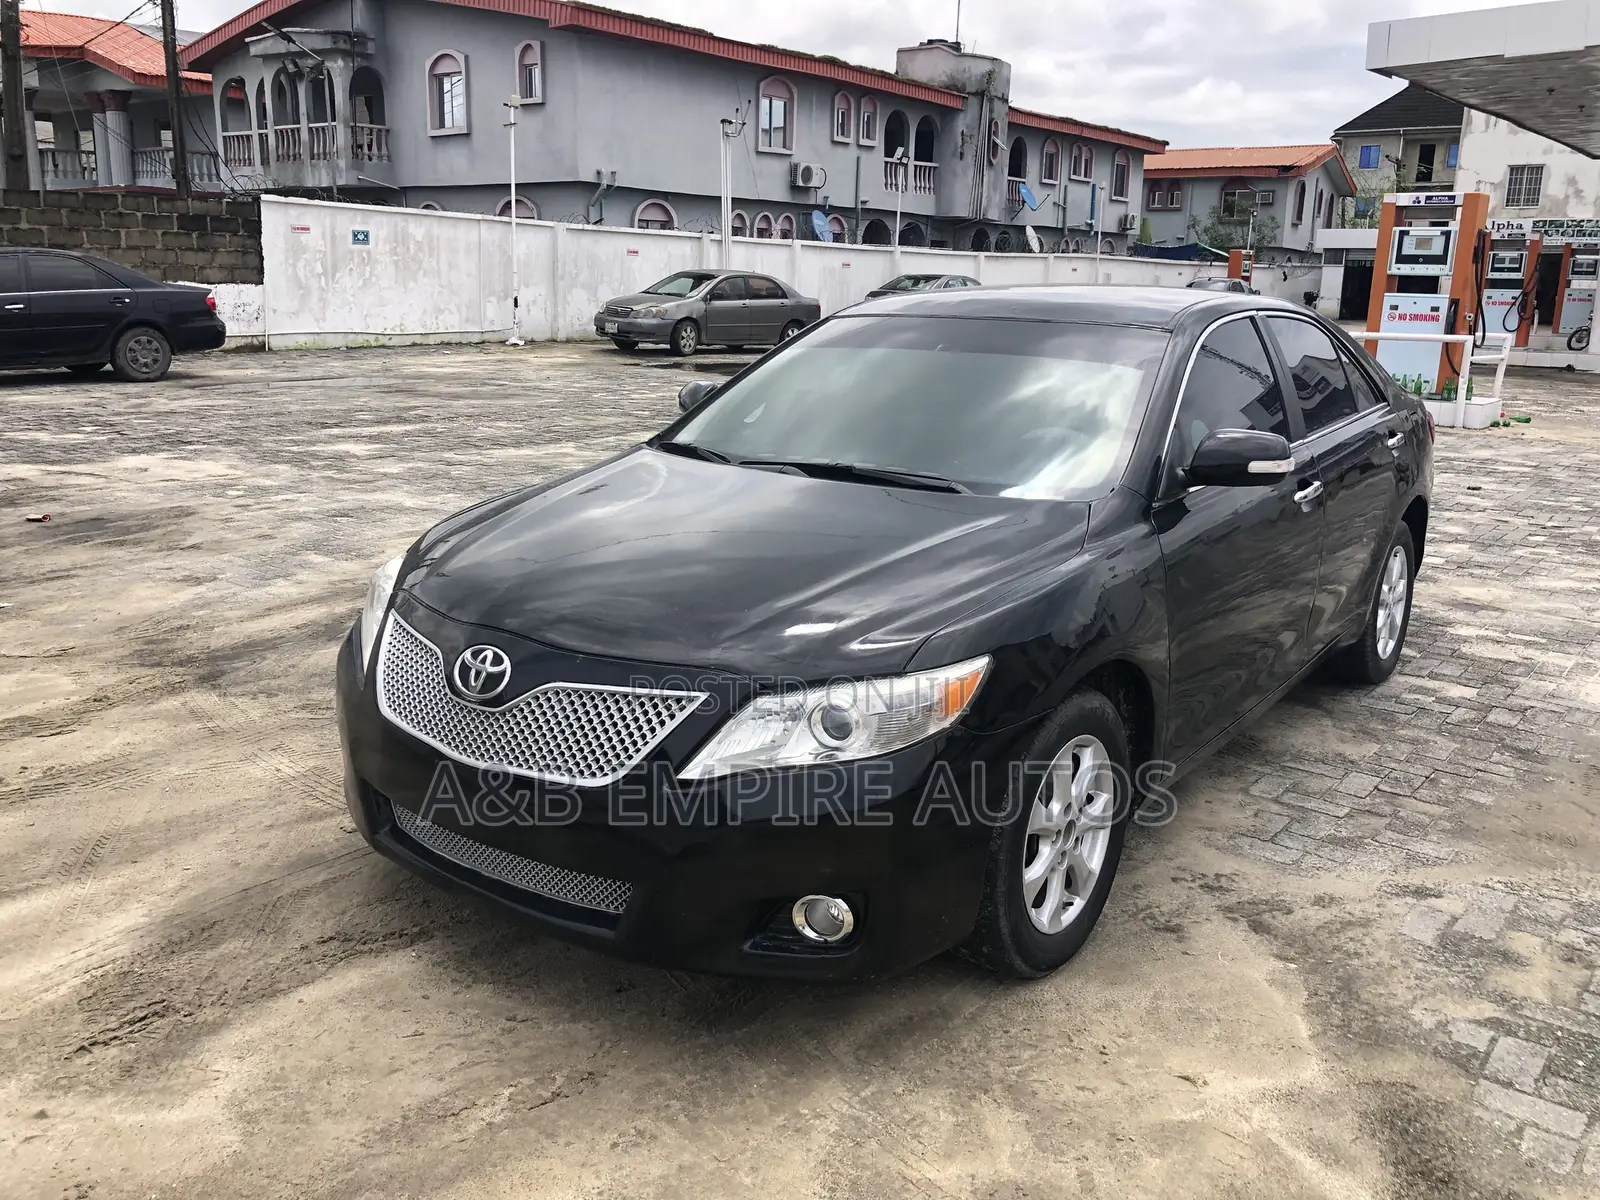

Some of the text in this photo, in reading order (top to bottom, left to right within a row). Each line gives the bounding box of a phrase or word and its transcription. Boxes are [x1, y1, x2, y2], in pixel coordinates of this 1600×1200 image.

[1485, 220, 1524, 233] lpha
[1398, 313, 1440, 322] NO SMOKING
